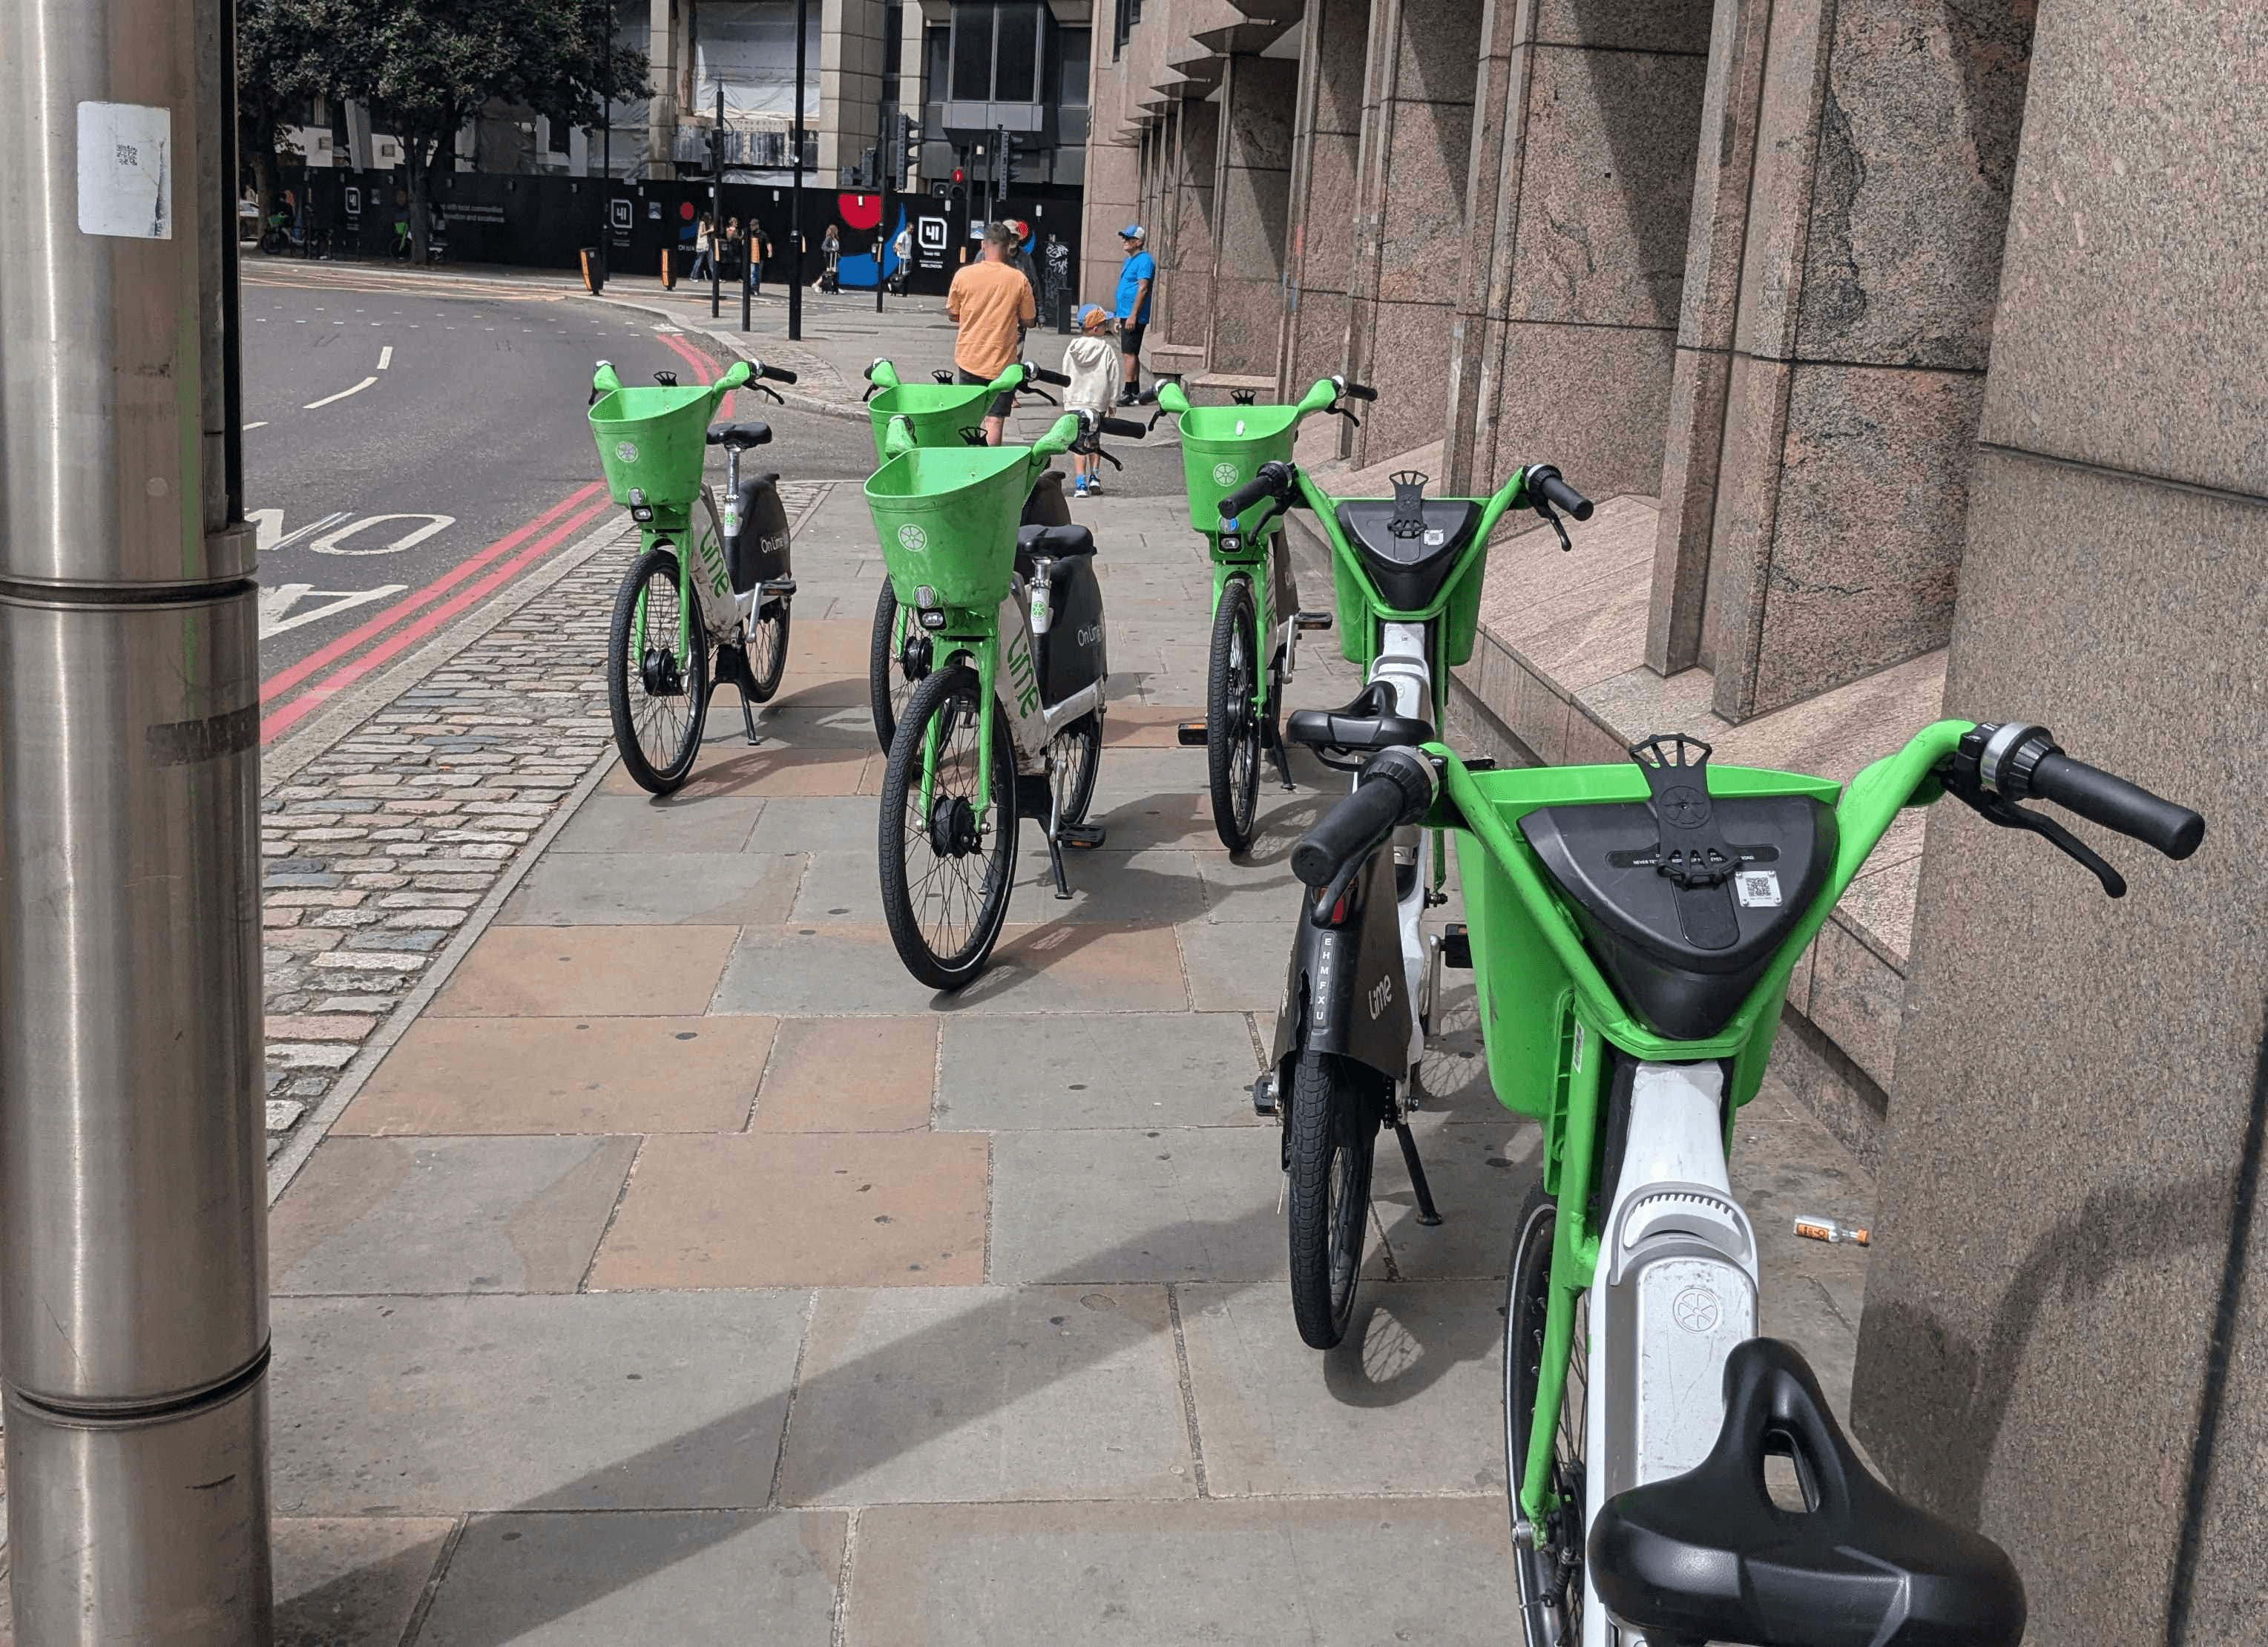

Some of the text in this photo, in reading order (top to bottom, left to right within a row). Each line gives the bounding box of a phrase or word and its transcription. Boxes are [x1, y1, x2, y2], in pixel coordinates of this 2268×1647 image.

[617, 207, 626, 220] 41
[926, 226, 939, 240] 41
[700, 525, 729, 599] Lime
[1008, 625, 1039, 719] Lime
[1368, 974, 1393, 1020] Lime
